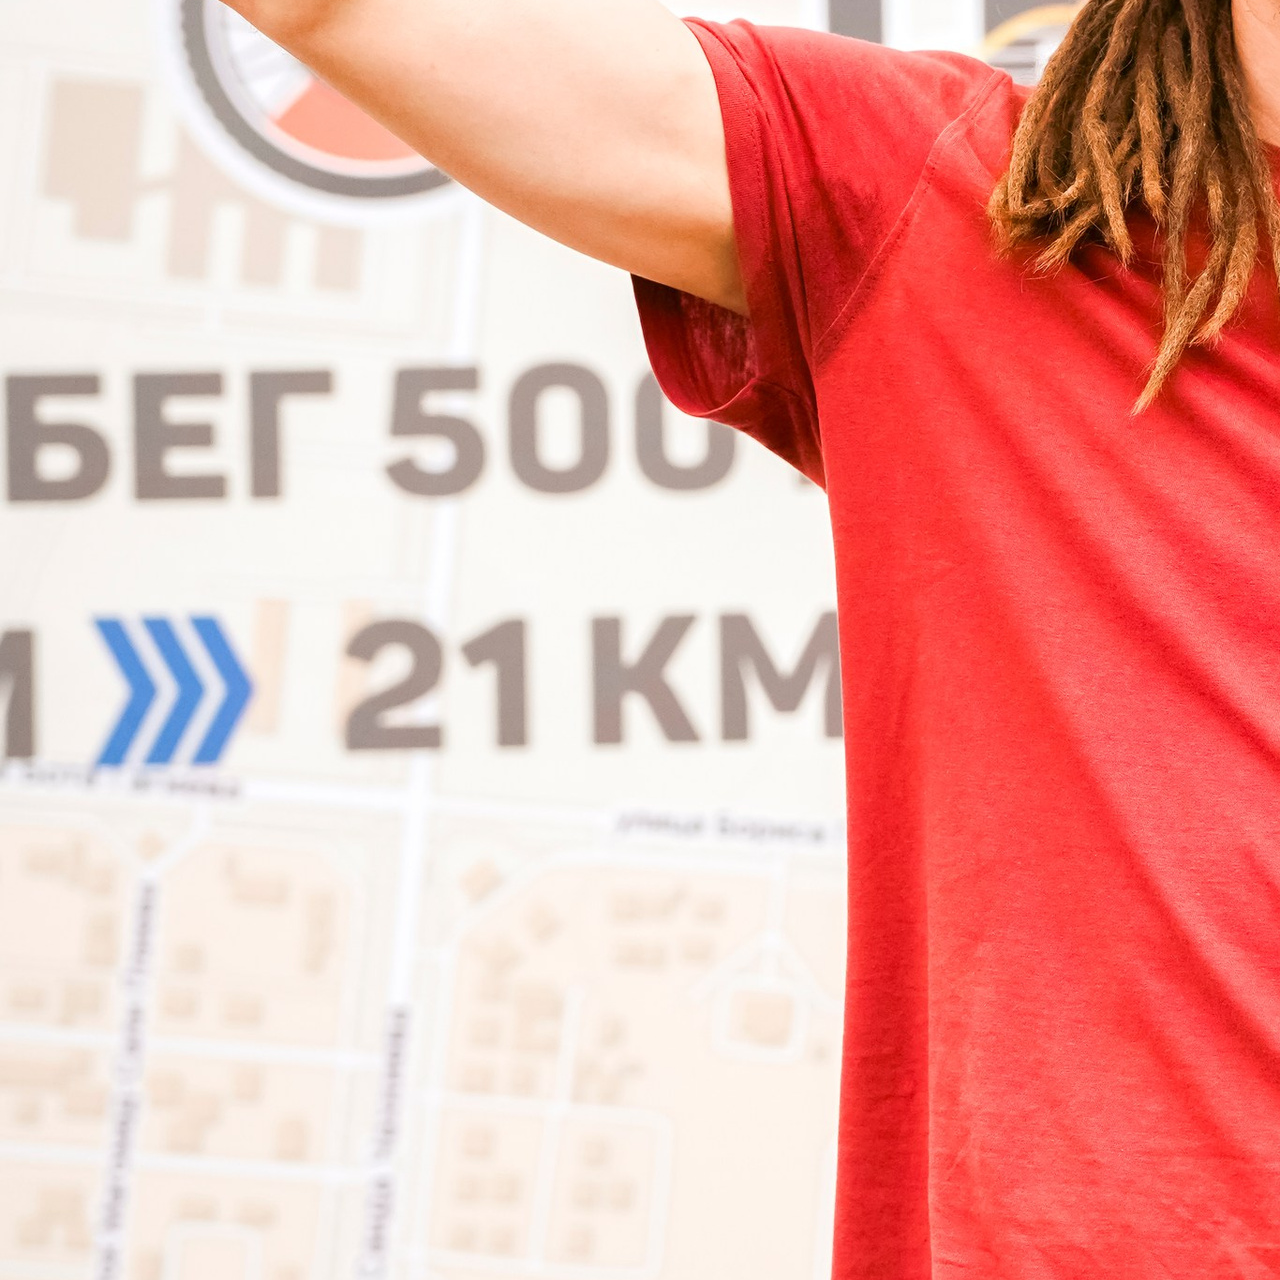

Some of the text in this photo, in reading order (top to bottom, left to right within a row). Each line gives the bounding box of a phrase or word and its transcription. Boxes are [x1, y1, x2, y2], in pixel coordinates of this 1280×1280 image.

[6, 362, 736, 502] БЕГ 500
[345, 611, 842, 752] 21 КМ
